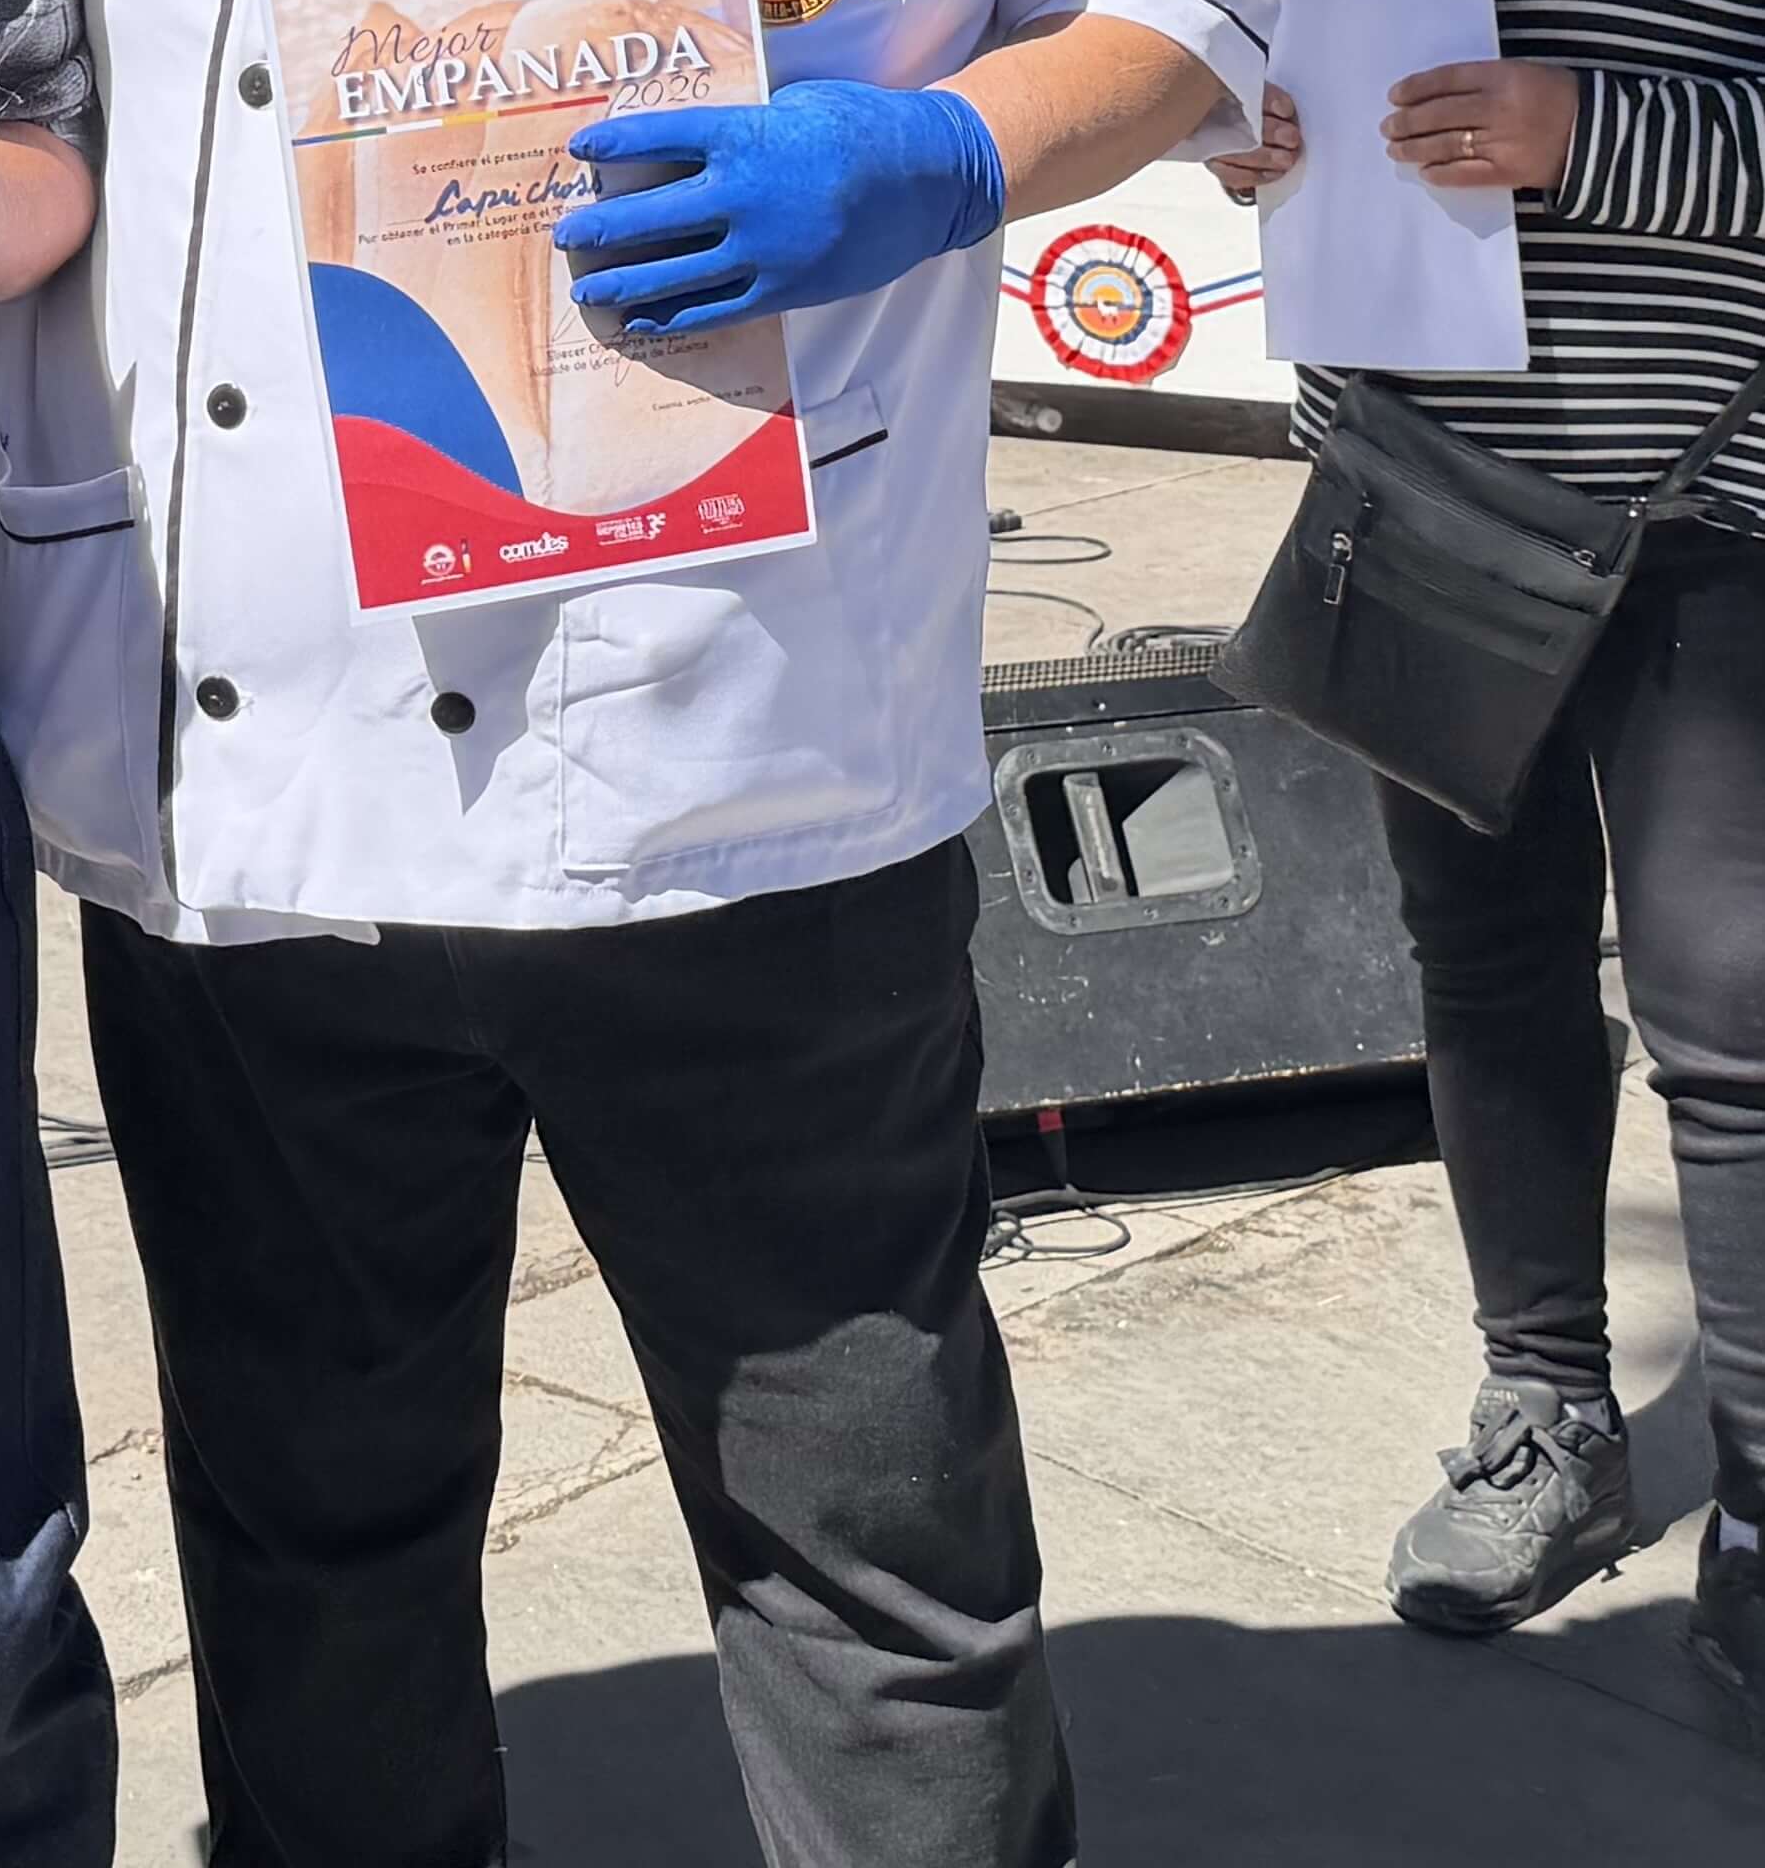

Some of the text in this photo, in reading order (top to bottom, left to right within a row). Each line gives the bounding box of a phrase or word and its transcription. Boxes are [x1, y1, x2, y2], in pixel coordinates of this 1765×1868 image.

[331, 22, 506, 87] Mejor
[333, 25, 712, 120] EMPANADA
[615, 68, 714, 111] 2026
